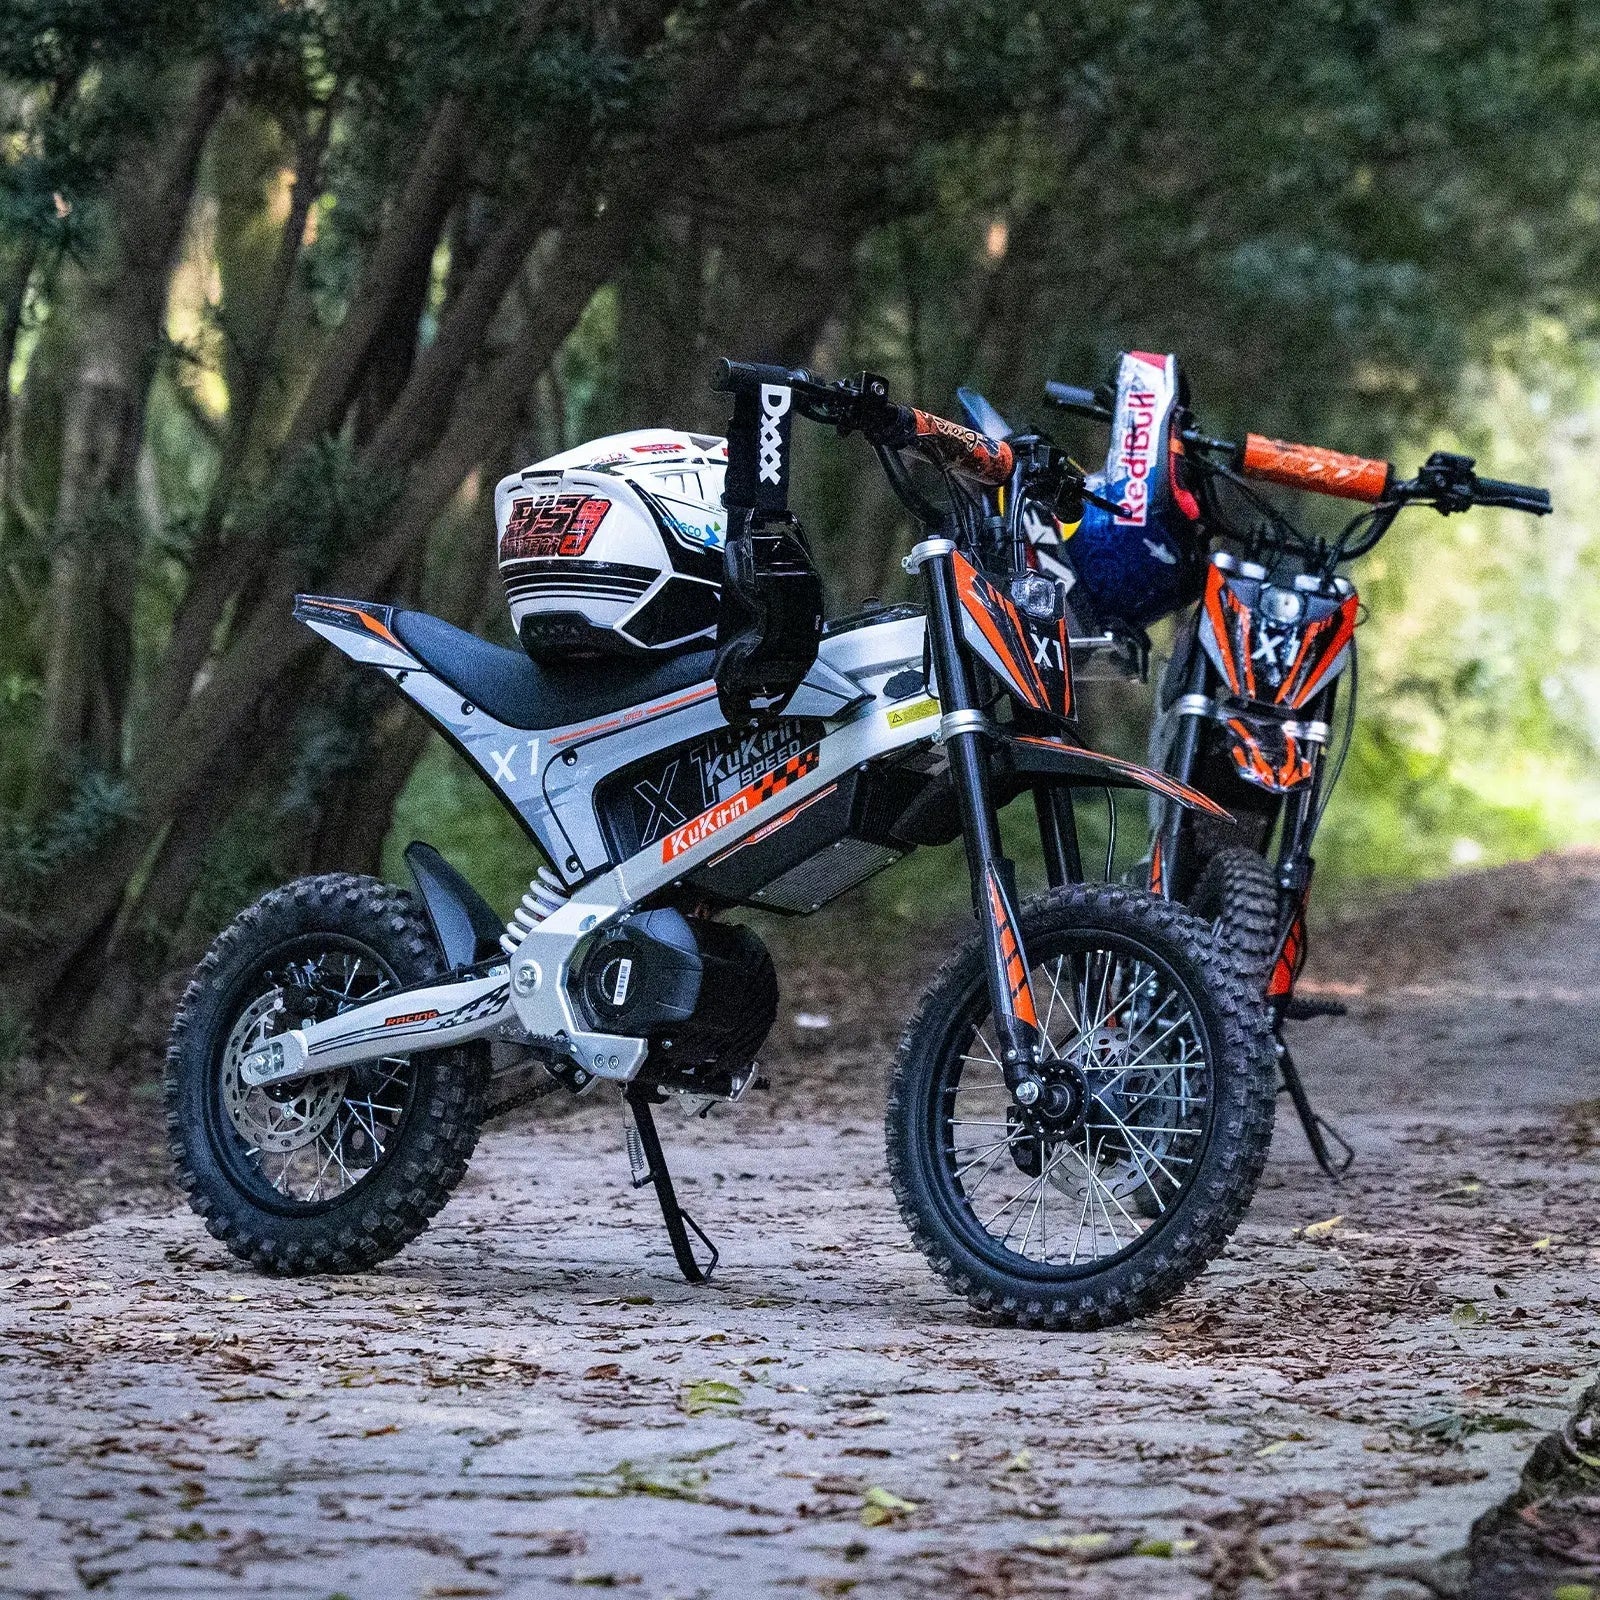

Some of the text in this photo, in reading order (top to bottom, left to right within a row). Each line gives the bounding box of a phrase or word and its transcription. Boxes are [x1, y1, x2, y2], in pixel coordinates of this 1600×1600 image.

[1030, 633, 1064, 672] X1
[740, 739, 801, 786] SPEED
[671, 795, 749, 856] KuKirin
